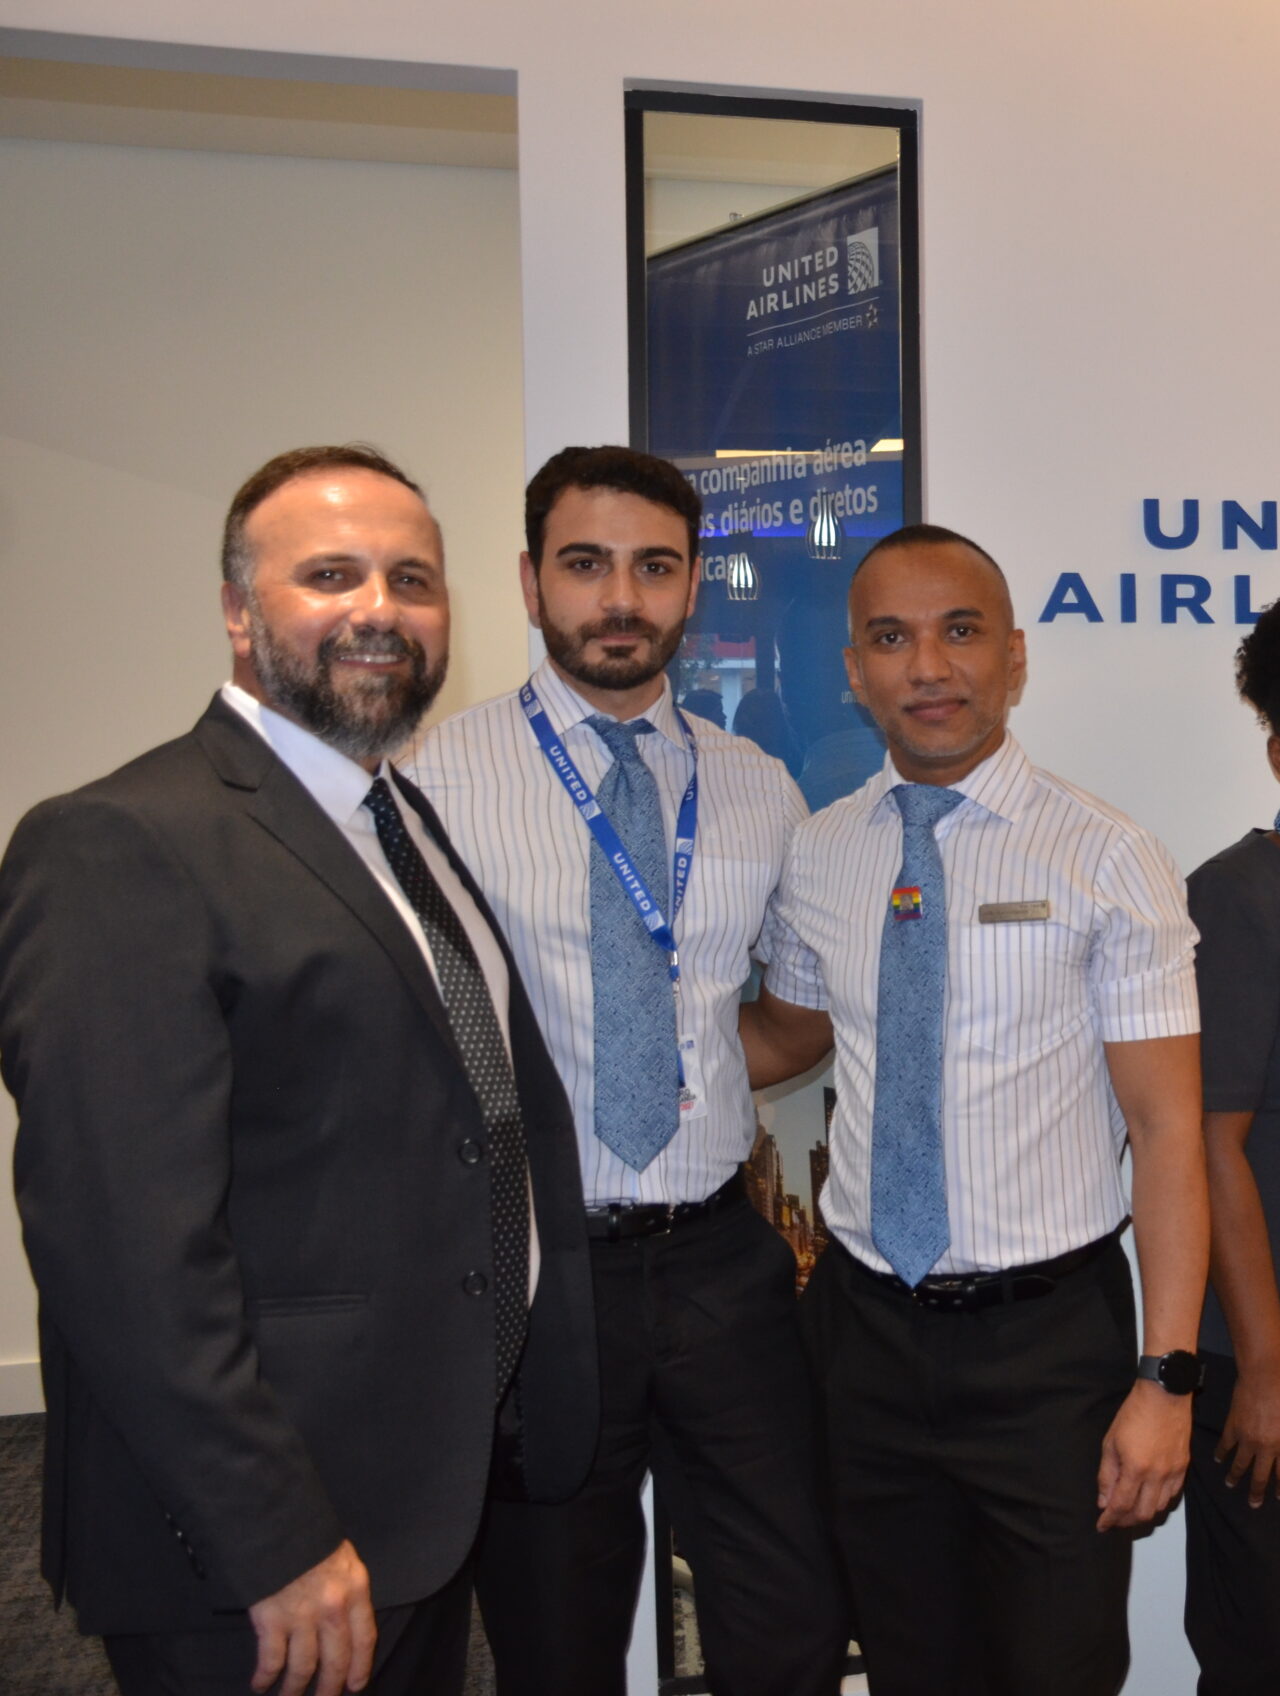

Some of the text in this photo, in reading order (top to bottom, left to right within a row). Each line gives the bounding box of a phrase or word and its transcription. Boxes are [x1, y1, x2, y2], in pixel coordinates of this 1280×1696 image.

[762, 246, 839, 288] UNITED
[746, 273, 840, 320] AIRLINES
[701, 446, 807, 496] companhia
[813, 437, 867, 476] aérea
[720, 498, 784, 536] diários
[789, 497, 804, 525] e
[809, 484, 879, 528] diretos
[550, 745, 588, 801] UNITED
[612, 852, 651, 911] UNITED
